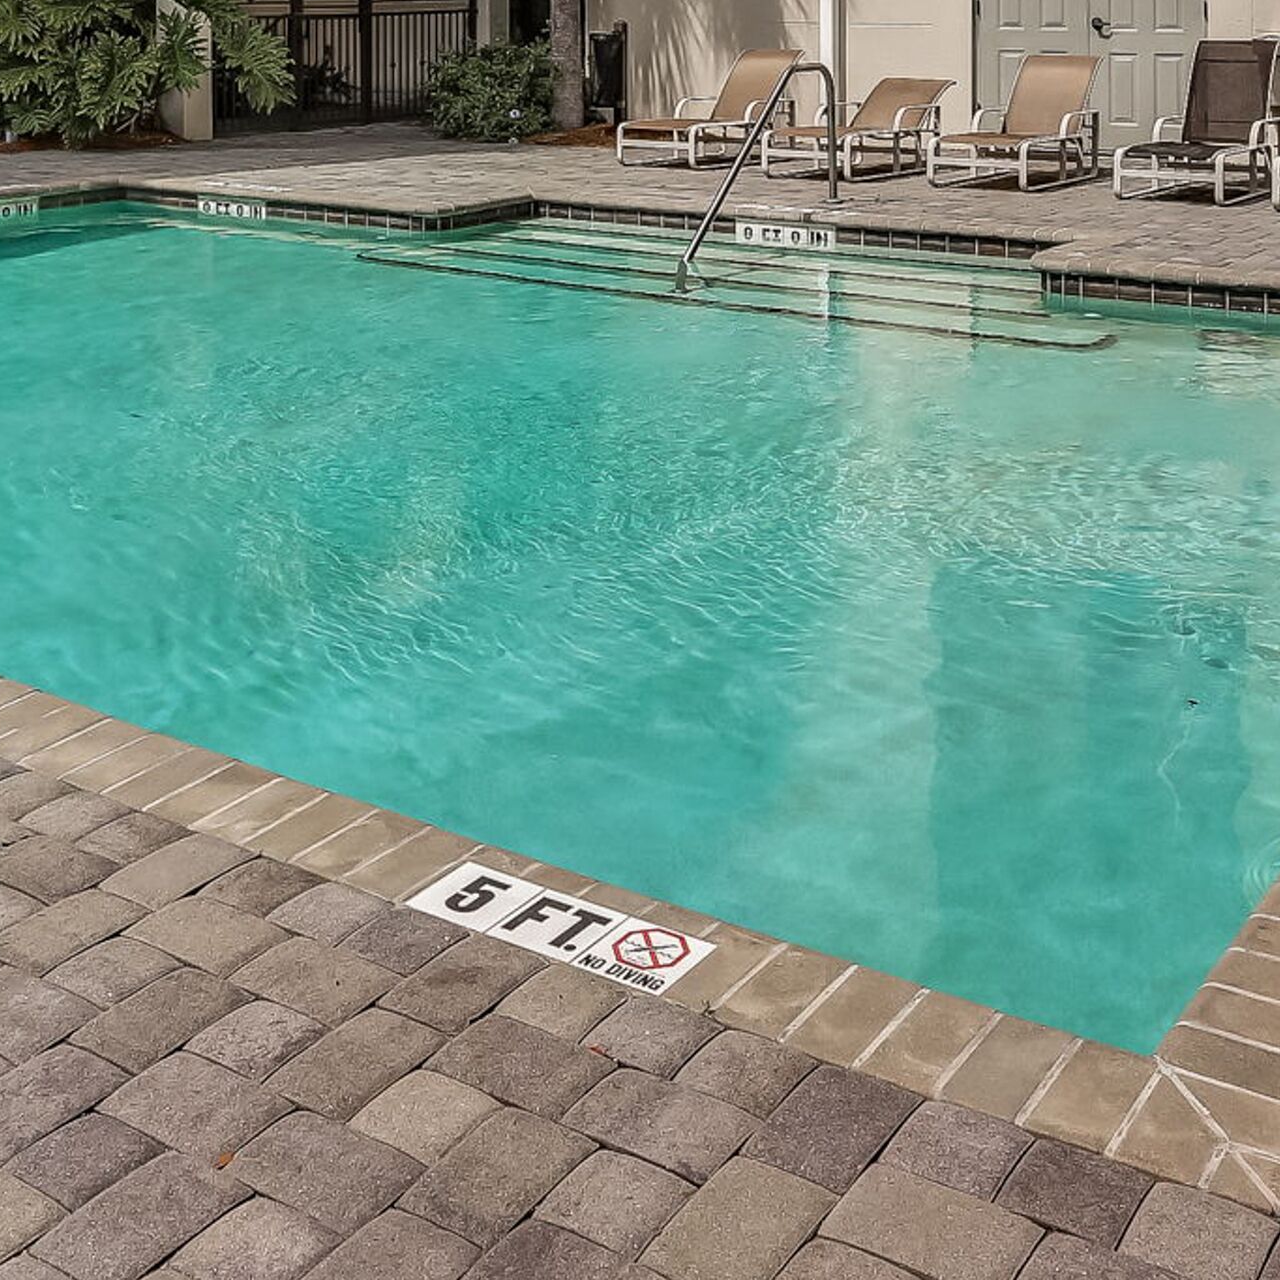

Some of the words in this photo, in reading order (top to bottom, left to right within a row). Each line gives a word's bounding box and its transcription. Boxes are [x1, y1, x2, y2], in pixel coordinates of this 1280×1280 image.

[444, 875, 512, 913] 5
[500, 897, 613, 952] FT.
[578, 954, 607, 969] NO
[605, 963, 665, 991] DIVING
